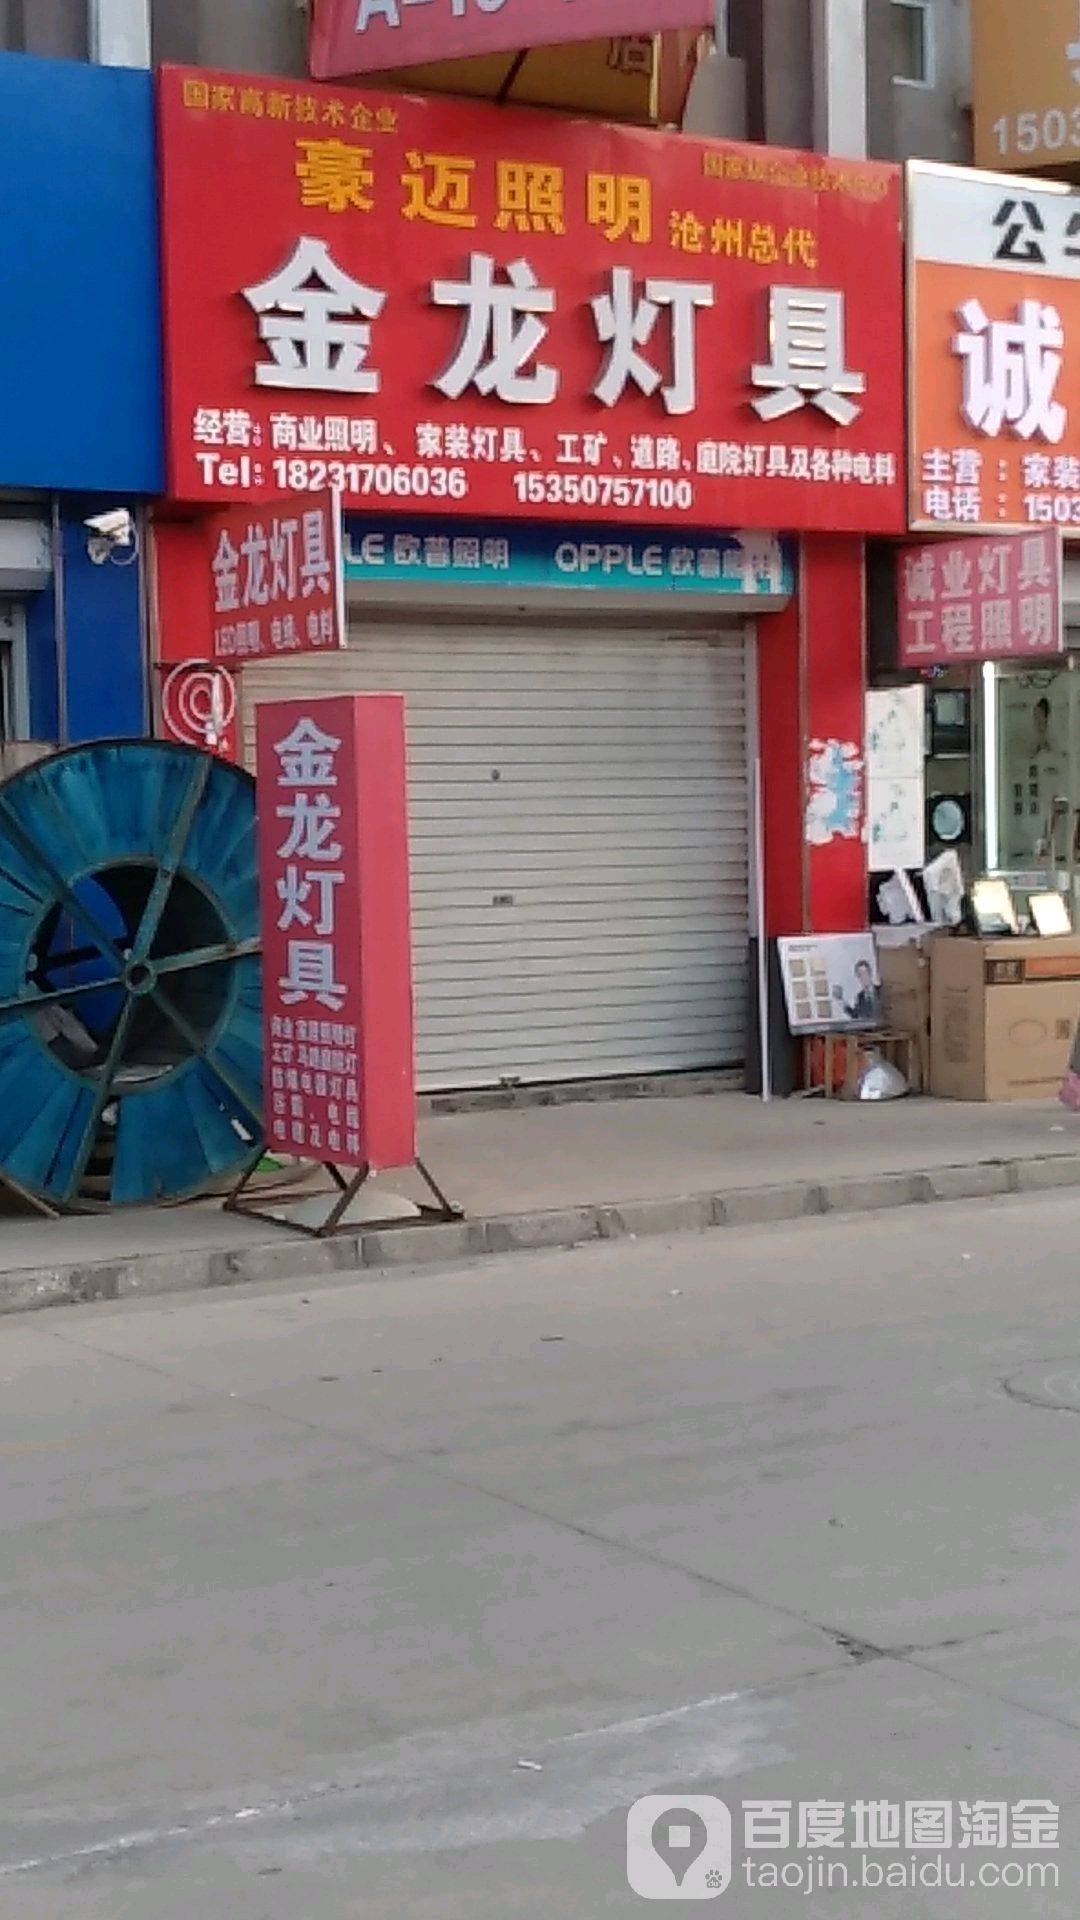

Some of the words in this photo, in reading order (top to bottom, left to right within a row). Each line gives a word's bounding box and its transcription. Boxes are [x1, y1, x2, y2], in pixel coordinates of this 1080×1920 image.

[183, 80, 398, 134] 国家高新技术企业
[295, 138, 653, 244] 豪迈照明
[668, 208, 819, 269] 沧州总代
[243, 236, 867, 427] 金龙灯具
[951, 298, 1066, 444] 诚
[273, 458, 467, 499] 18231706036
[514, 470, 693, 509] 15350757100
[212, 510, 330, 613] 金龙灯具
[555, 541, 663, 576] OPPLE
[670, 547, 778, 582] 欧普照
[905, 536, 1051, 602] 诚业灯具
[905, 592, 1053, 655] 工程照明
[273, 715, 348, 1012] 金龙灯具
